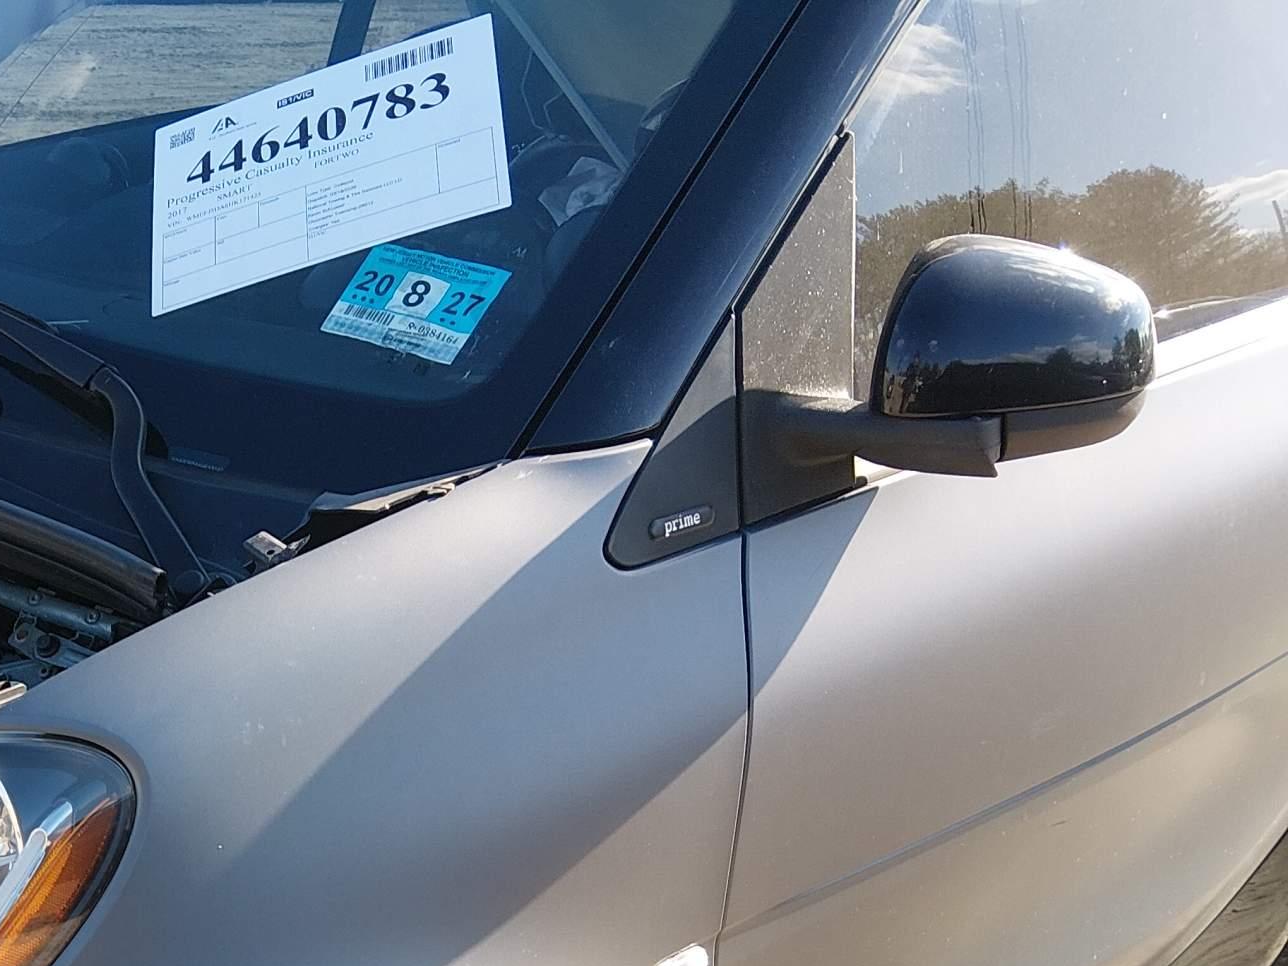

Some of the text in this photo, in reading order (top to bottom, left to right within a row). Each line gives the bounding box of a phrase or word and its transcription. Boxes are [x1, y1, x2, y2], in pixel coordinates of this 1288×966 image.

[186, 72, 450, 184] 44640783
[167, 175, 242, 208] Progressive
[245, 155, 303, 180] Casualty
[308, 131, 374, 159] Insurance
[167, 206, 188, 220] 2017
[216, 183, 253, 201] SMART
[355, 271, 394, 296] 20
[402, 280, 431, 307] 8
[441, 292, 486, 316] 27
[664, 512, 701, 537] prime
